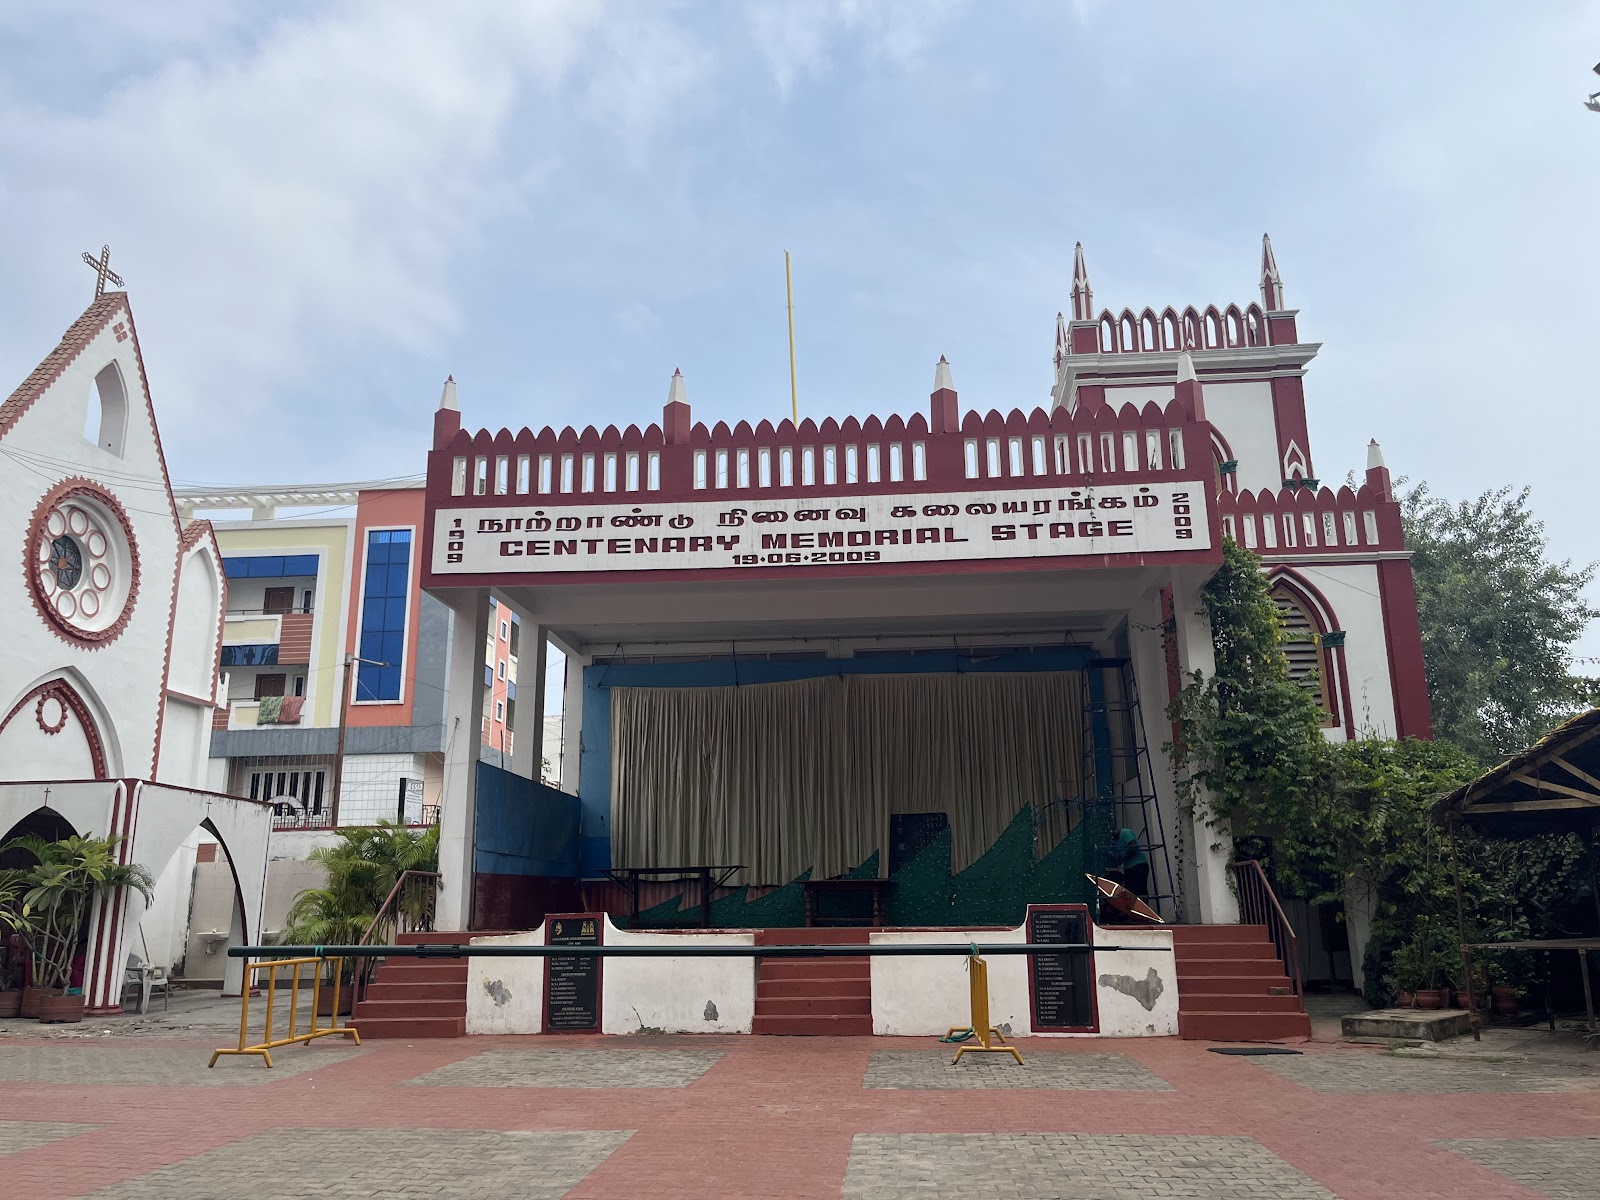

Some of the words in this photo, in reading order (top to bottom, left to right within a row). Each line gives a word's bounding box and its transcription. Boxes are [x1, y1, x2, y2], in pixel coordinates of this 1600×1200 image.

[477, 508, 695, 533] நூற்றாண்டு
[717, 508, 866, 527] நினைவு
[891, 487, 1159, 518] கலையரங்கம்
[1172, 493, 1193, 540] 2009
[447, 518, 464, 563] 1909
[500, 534, 740, 556] CENTENARY
[762, 527, 969, 549] MEMORIAL
[992, 520, 1134, 540] STAGE
